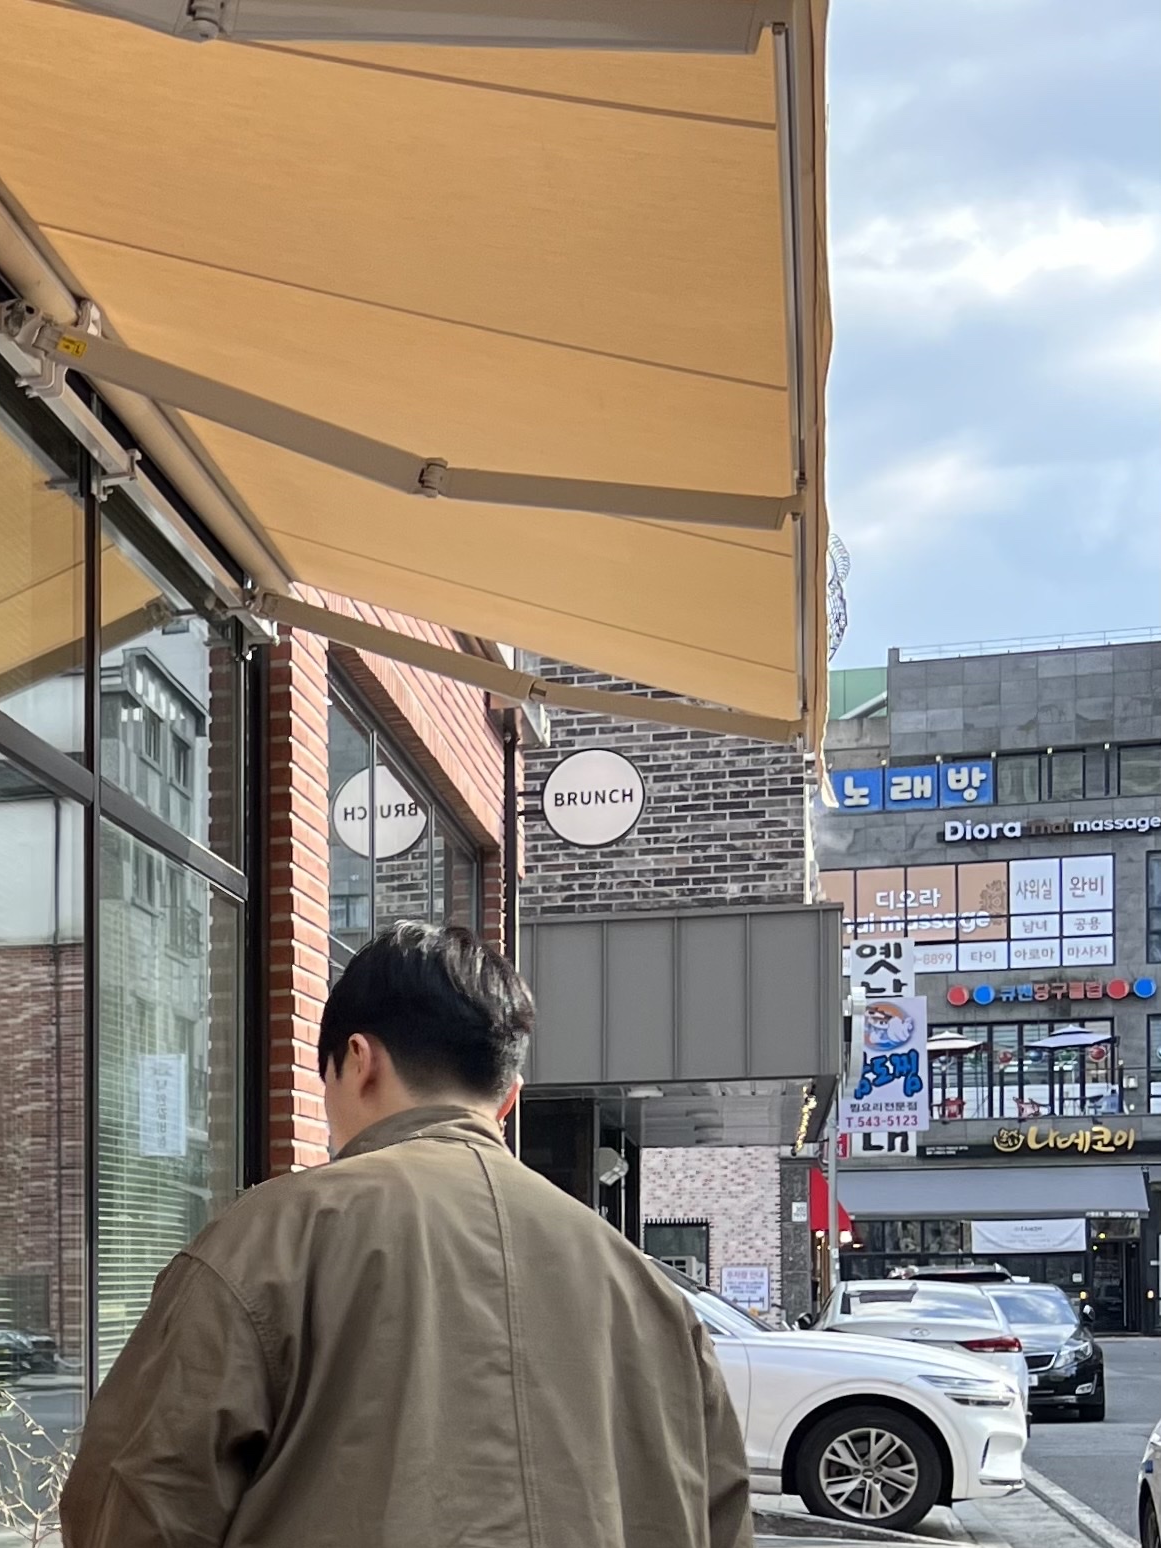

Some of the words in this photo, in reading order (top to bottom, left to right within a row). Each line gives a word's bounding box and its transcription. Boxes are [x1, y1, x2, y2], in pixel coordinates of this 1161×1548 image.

[554, 788, 633, 807] BRUNCH
[844, 767, 986, 806] 노래방
[945, 820, 1022, 841] Diora
[1073, 816, 1161, 832] massage
[1070, 876, 1104, 898] 완비
[876, 888, 941, 909] 디오라
[880, 911, 990, 933] massage
[1074, 916, 1101, 931] 공용
[970, 951, 997, 964] 타이
[1067, 945, 1108, 958] 마사지
[1027, 1126, 1135, 1153] 나베코이
